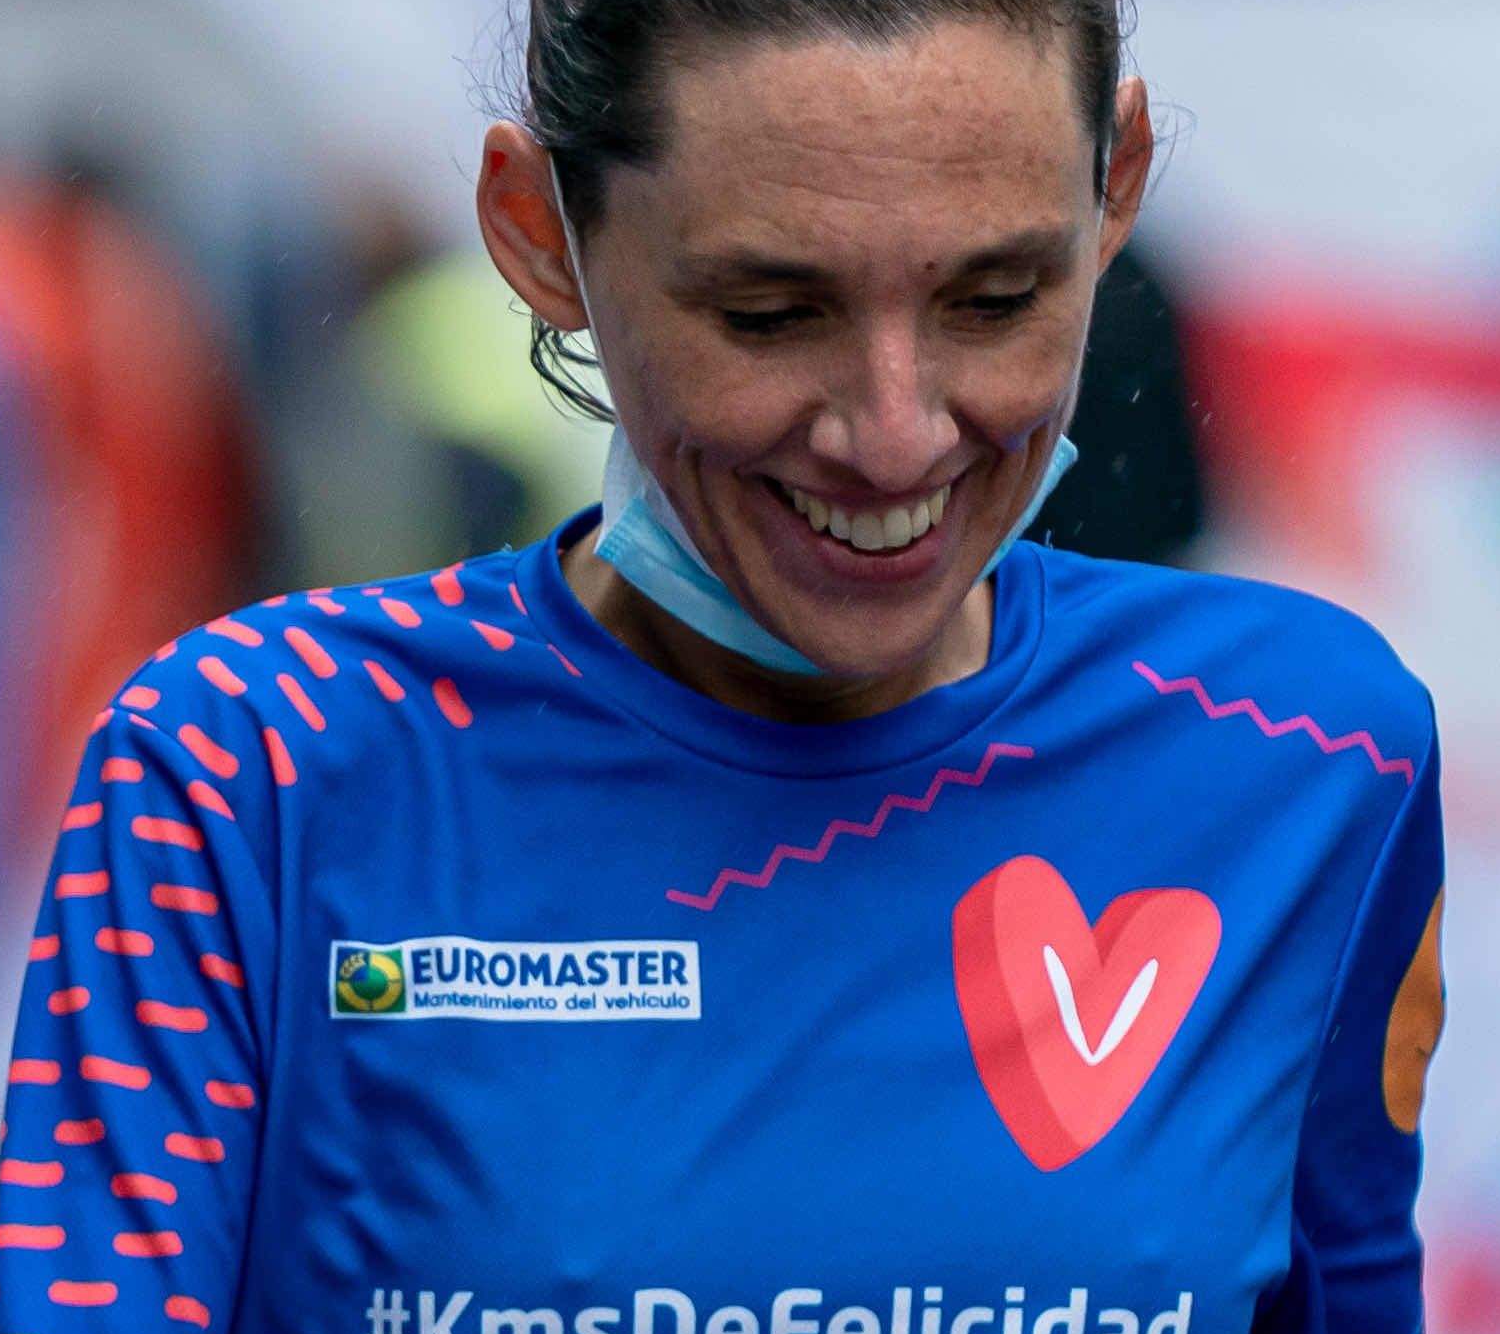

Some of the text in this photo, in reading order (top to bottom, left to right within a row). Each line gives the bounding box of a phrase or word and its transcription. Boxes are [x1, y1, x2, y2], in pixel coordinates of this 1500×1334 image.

[411, 946, 689, 988] EUROMASTER
[413, 989, 691, 1012] Mantenimiento del vehículo
